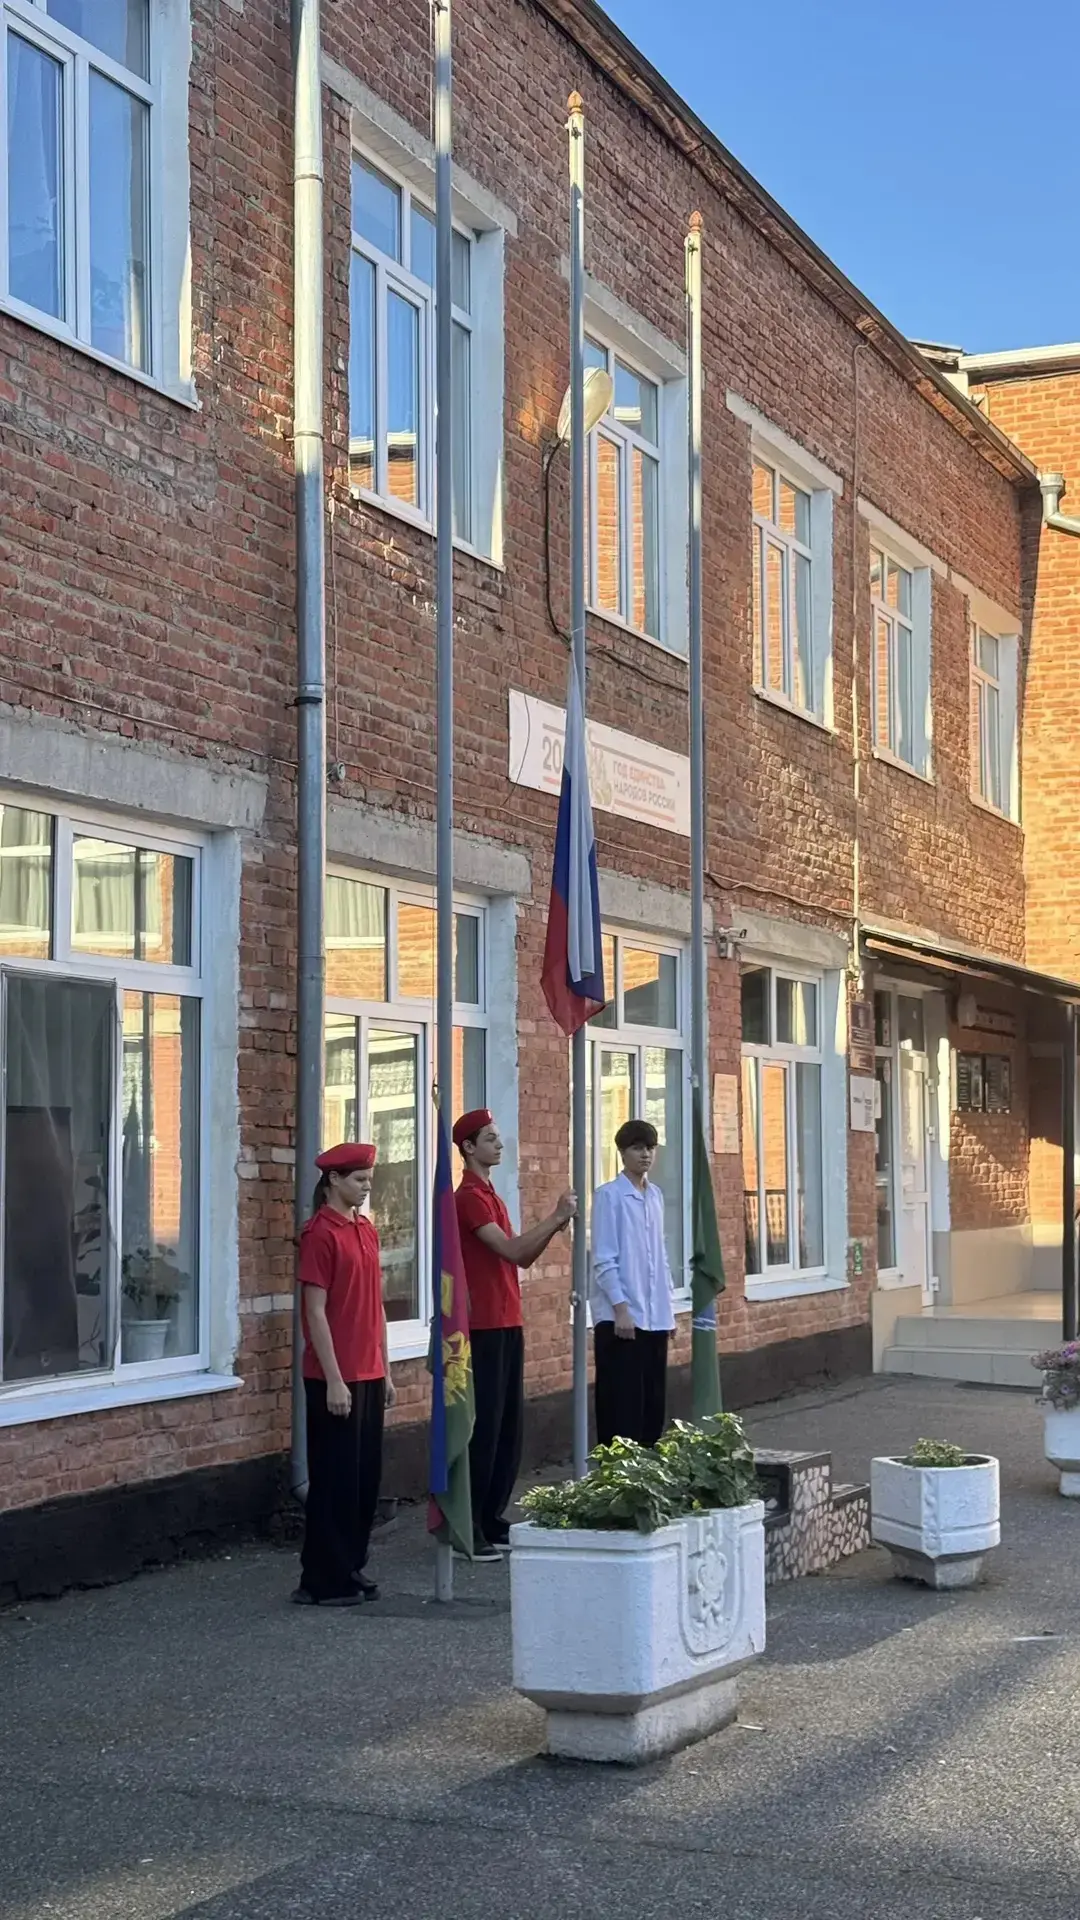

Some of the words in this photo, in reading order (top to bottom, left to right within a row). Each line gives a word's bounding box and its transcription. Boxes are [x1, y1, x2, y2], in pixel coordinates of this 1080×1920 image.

[613, 760, 628, 780] ГОД
[630, 766, 666, 789] ЕДИНСТВА
[613, 779, 647, 802] НАРОДОВ
[648, 790, 675, 812] РОССИИ
